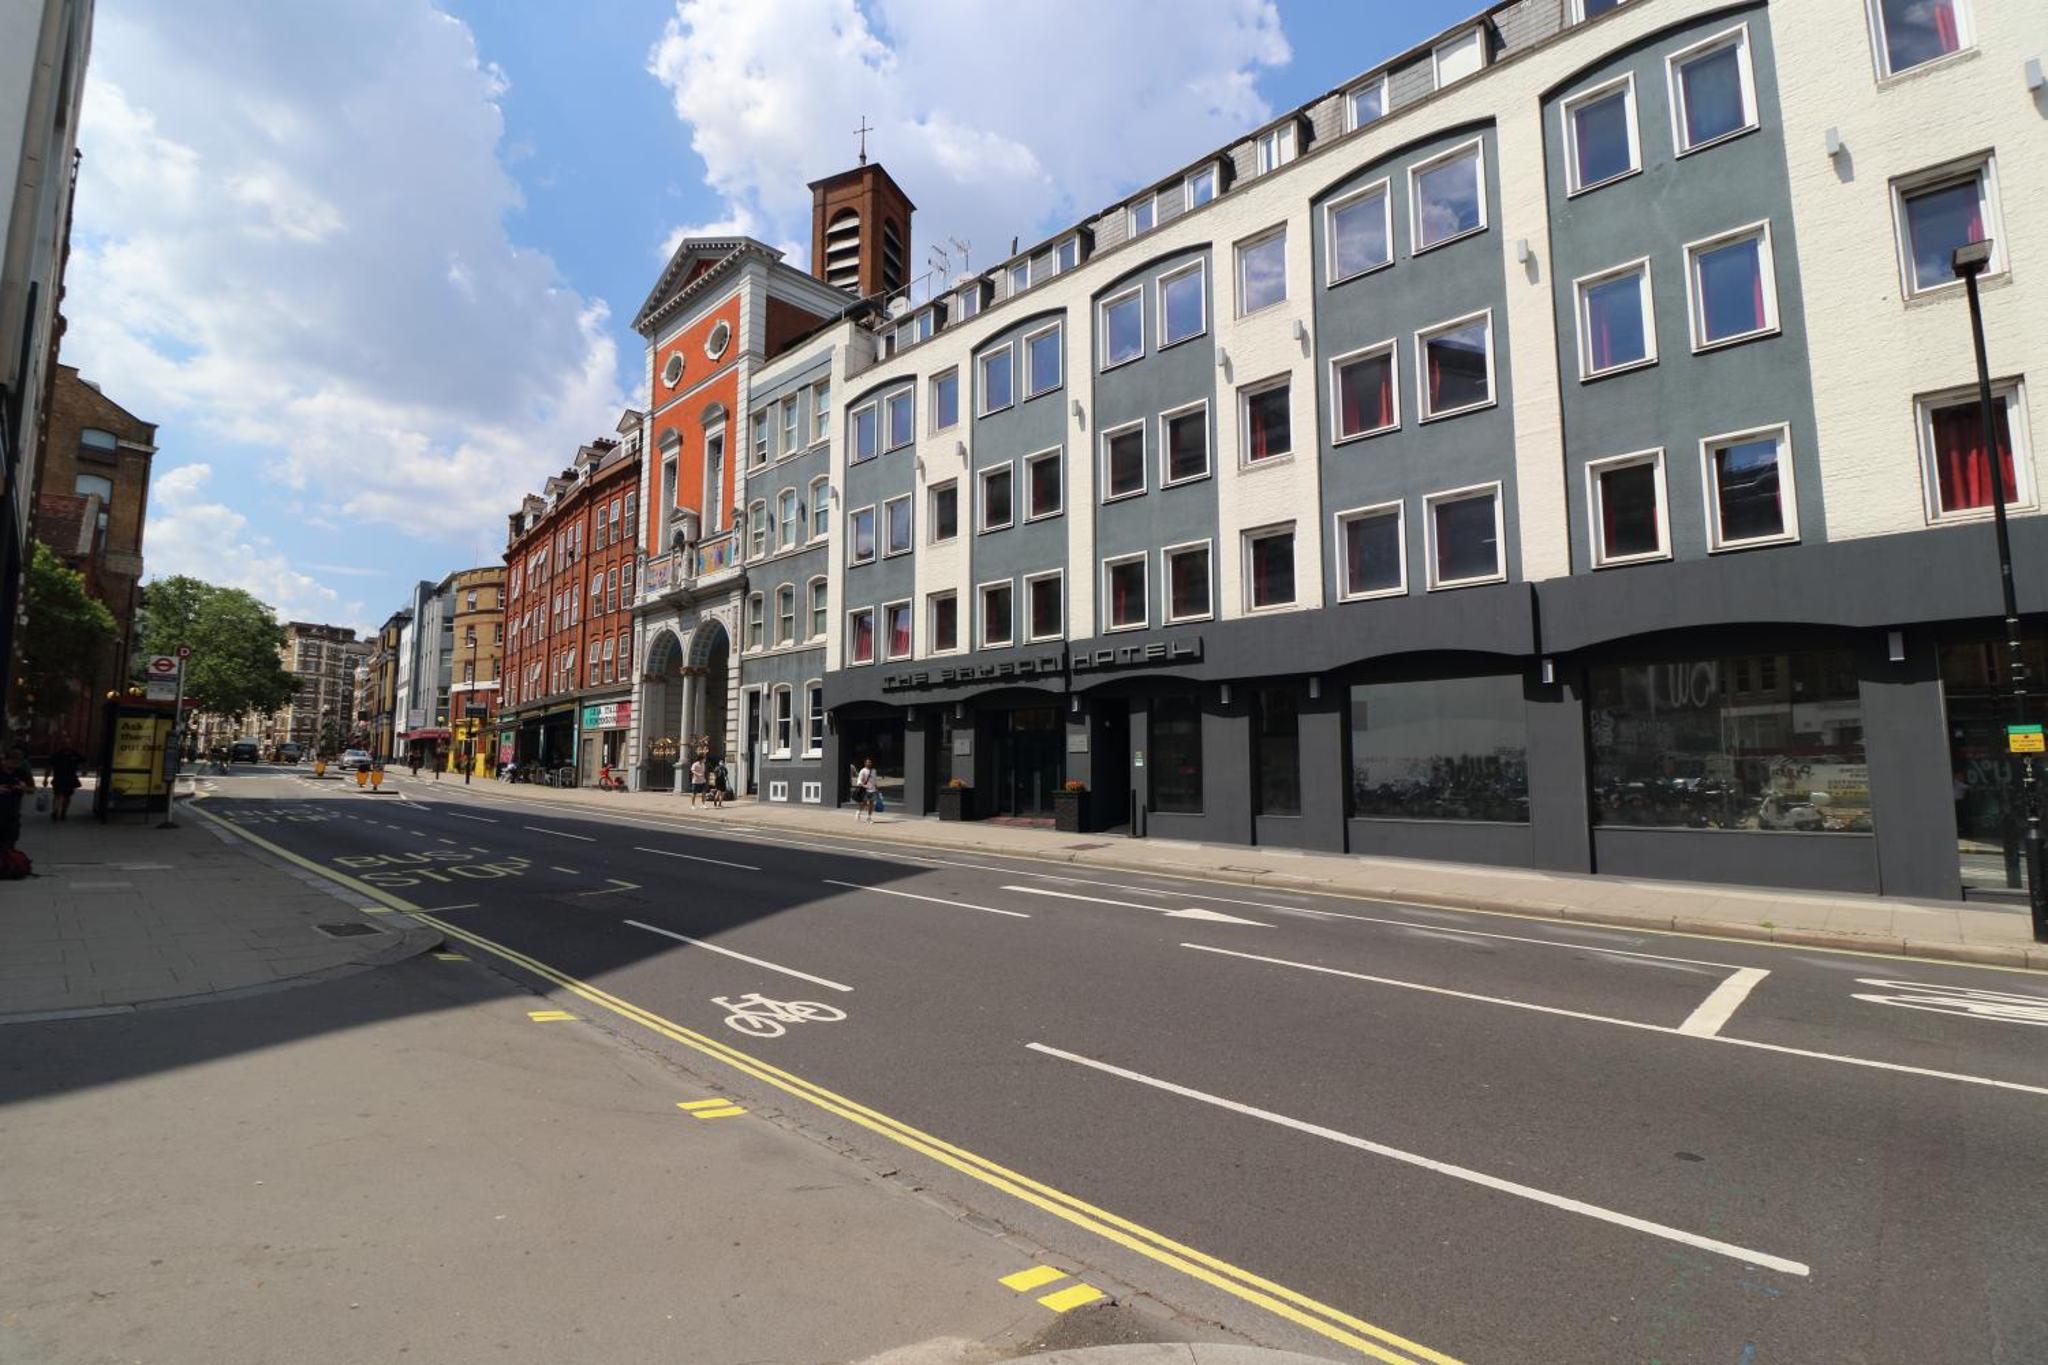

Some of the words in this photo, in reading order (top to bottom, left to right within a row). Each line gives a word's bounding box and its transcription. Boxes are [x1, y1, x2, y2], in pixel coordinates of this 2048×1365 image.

[884, 671, 929, 688] THE
[1071, 640, 1195, 668] HOTEL
[333, 850, 475, 868] BUS
[359, 862, 530, 887] STOP
